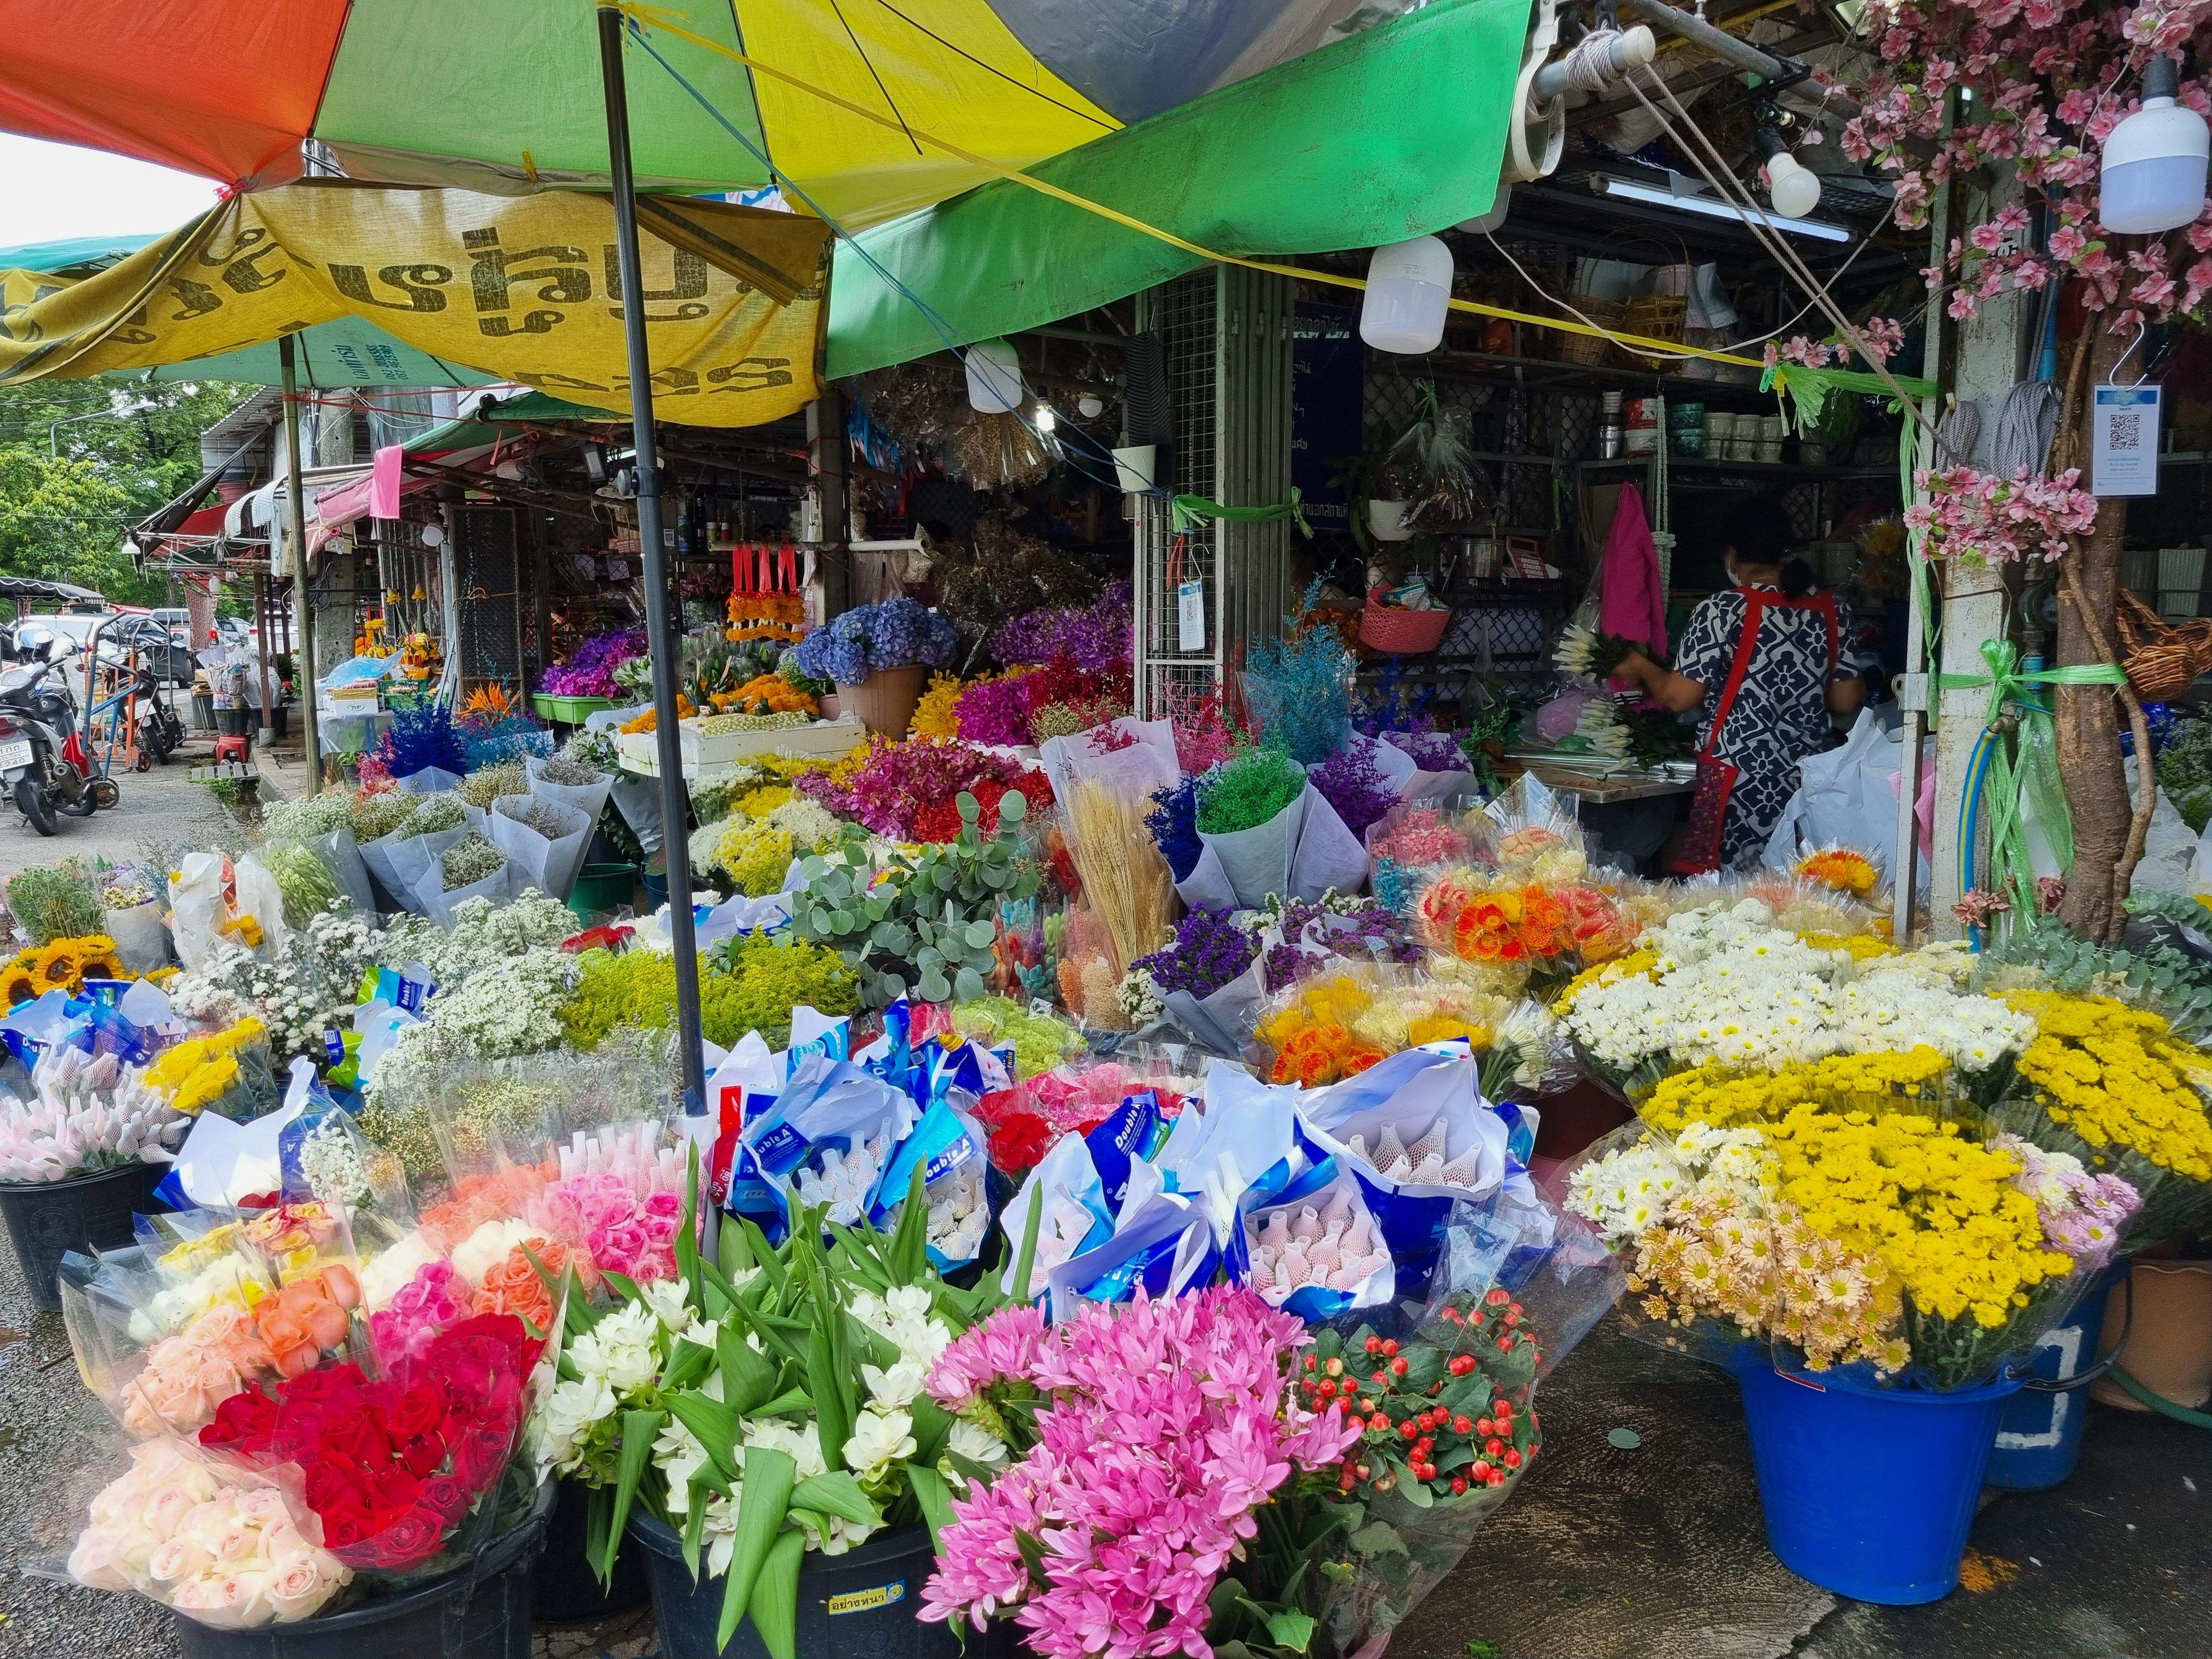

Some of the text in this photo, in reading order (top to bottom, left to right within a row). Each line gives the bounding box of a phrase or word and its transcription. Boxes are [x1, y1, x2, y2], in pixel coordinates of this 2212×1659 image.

[402, 985, 410, 1005] Double
[758, 1136, 780, 1154] uble
[782, 1128, 791, 1138] A
[1115, 1109, 1138, 1149] Double
[927, 1138, 970, 1178] ouble A
[832, 1594, 884, 1610] อย่างหนา
